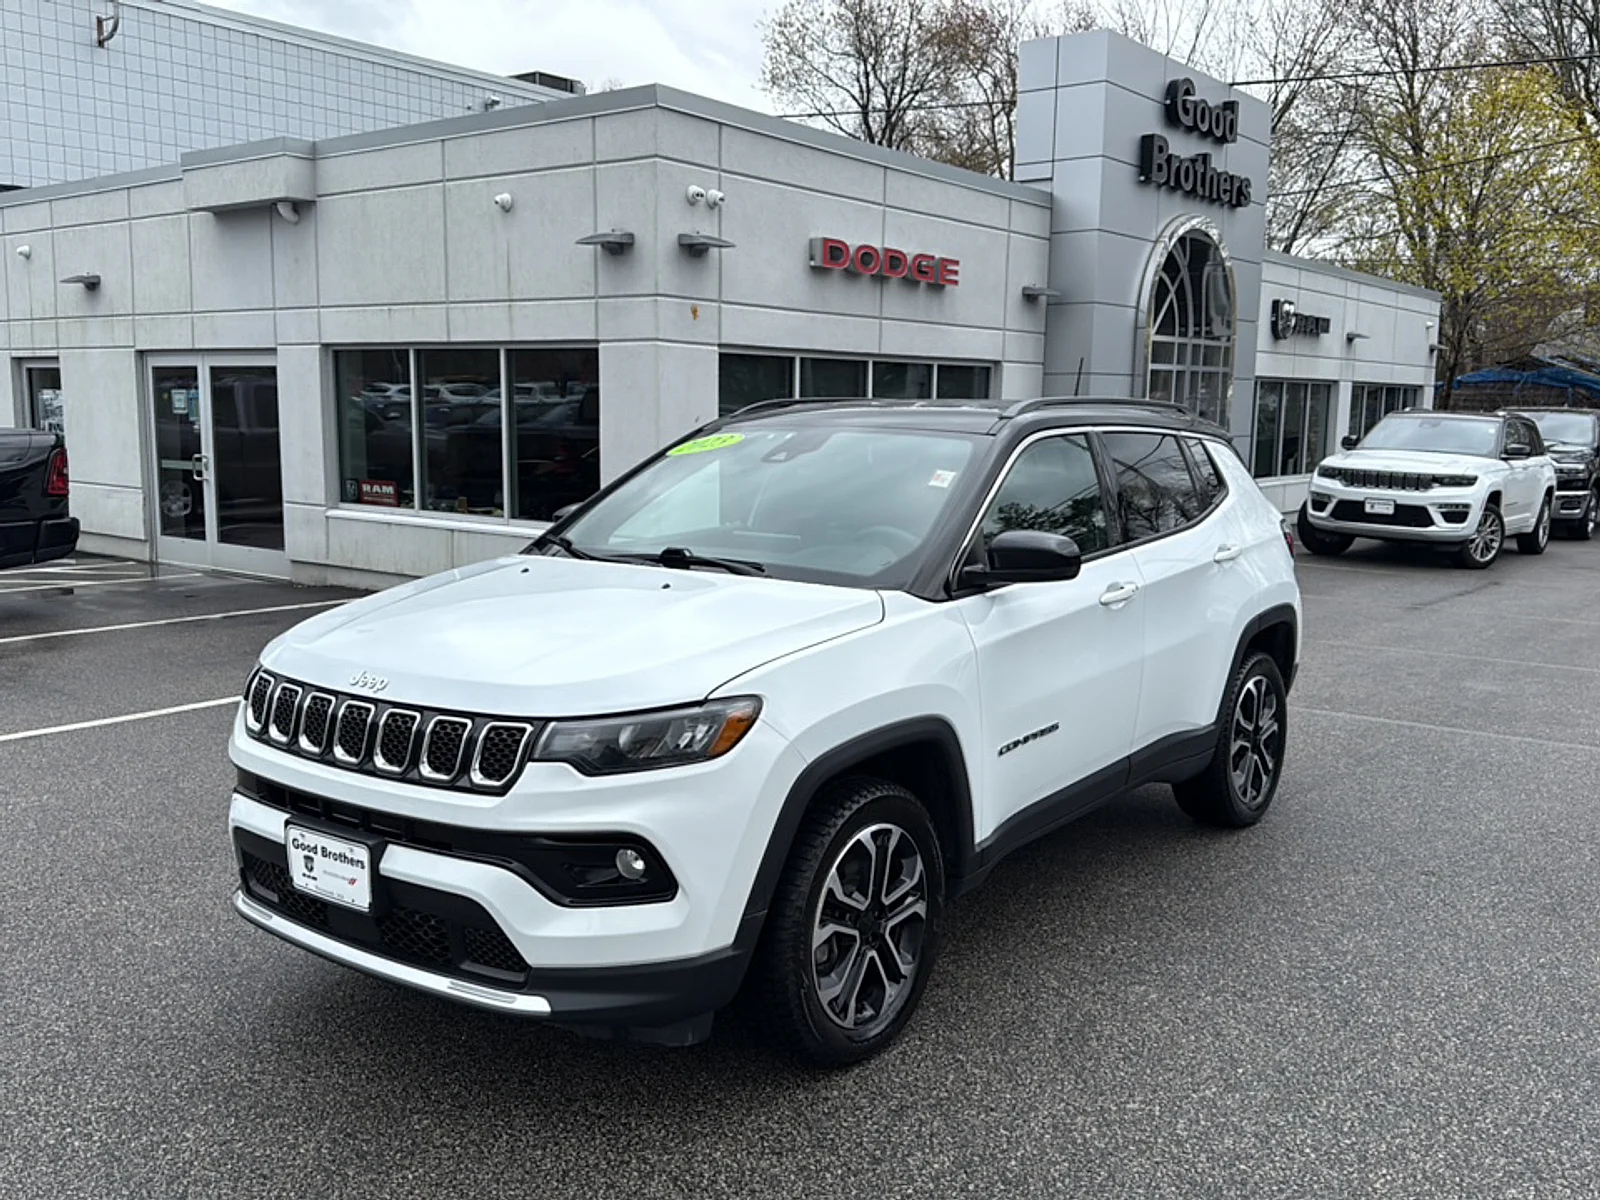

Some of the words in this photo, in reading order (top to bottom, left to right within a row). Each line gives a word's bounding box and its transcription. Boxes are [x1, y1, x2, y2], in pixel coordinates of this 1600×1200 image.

[1166, 77, 1239, 143] Good
[1141, 134, 1252, 207] Brothers
[811, 237, 960, 286] DODGE
[362, 483, 395, 495] RAM
[350, 670, 389, 693] Jeep
[291, 838, 318, 855] Good
[320, 846, 366, 870] Brothers
